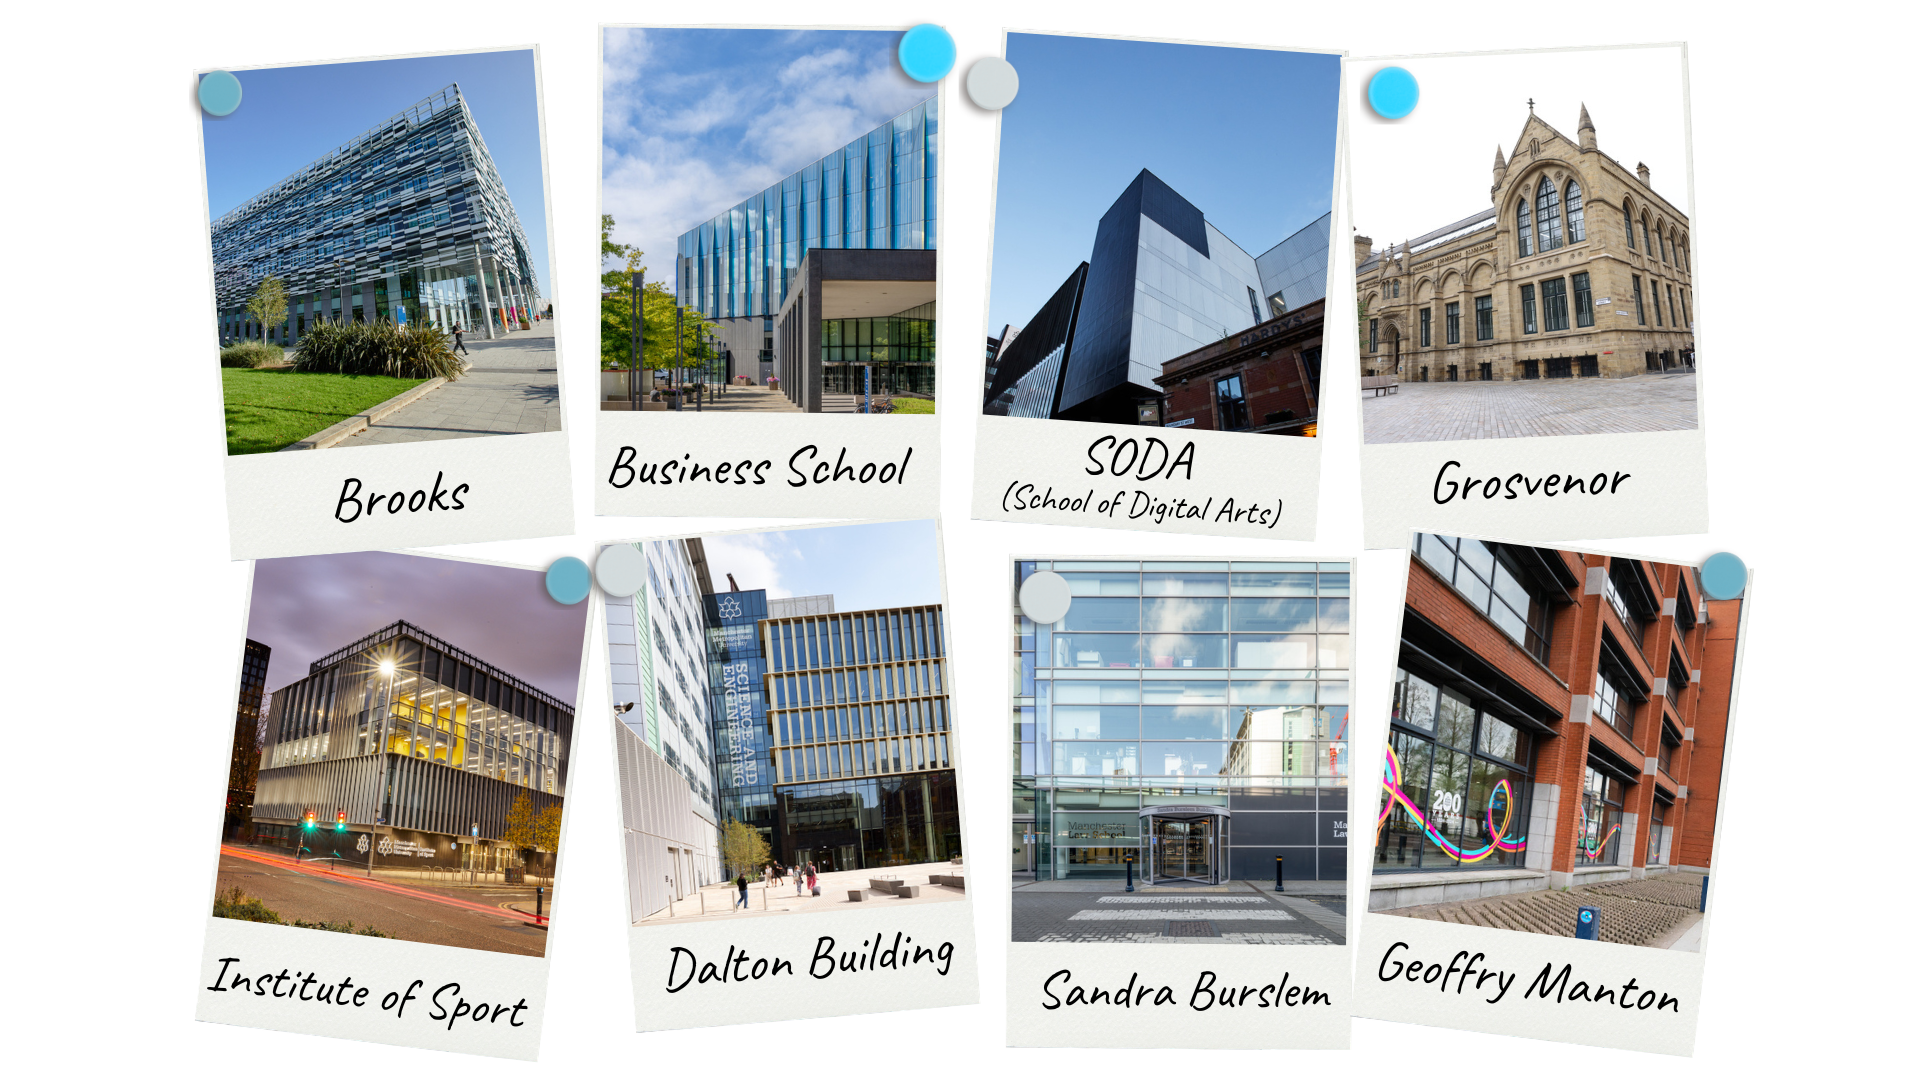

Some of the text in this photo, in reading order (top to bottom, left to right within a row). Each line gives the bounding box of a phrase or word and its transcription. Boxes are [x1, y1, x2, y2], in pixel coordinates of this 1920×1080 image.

[722, 664, 746, 788] ENGINEERING
[735, 663, 758, 785] SCIENCE AND
[1432, 789, 1462, 813] 200
[1432, 809, 1461, 820] YEARS
[1067, 821, 1126, 831] Manchester
[1068, 830, 1126, 839] Law School
